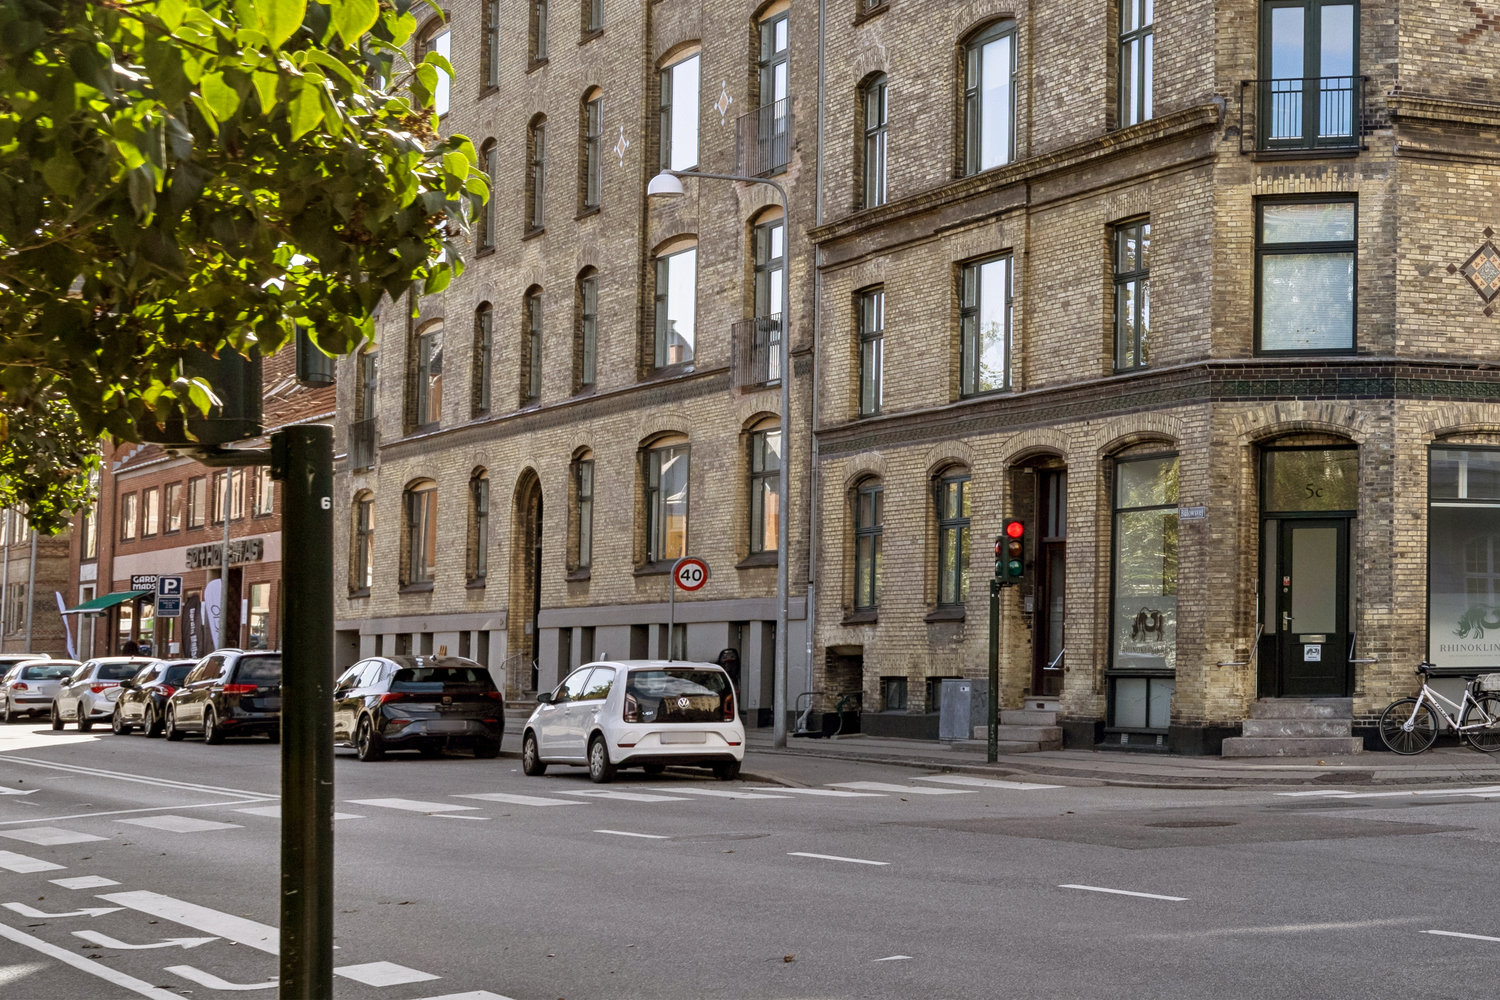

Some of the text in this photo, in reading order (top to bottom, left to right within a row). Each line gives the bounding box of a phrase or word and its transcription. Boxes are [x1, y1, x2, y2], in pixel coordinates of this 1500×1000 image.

[1305, 482, 1324, 499] 5c
[321, 496, 331, 510] 6
[680, 569, 702, 581] 40
[164, 578, 178, 594] P
